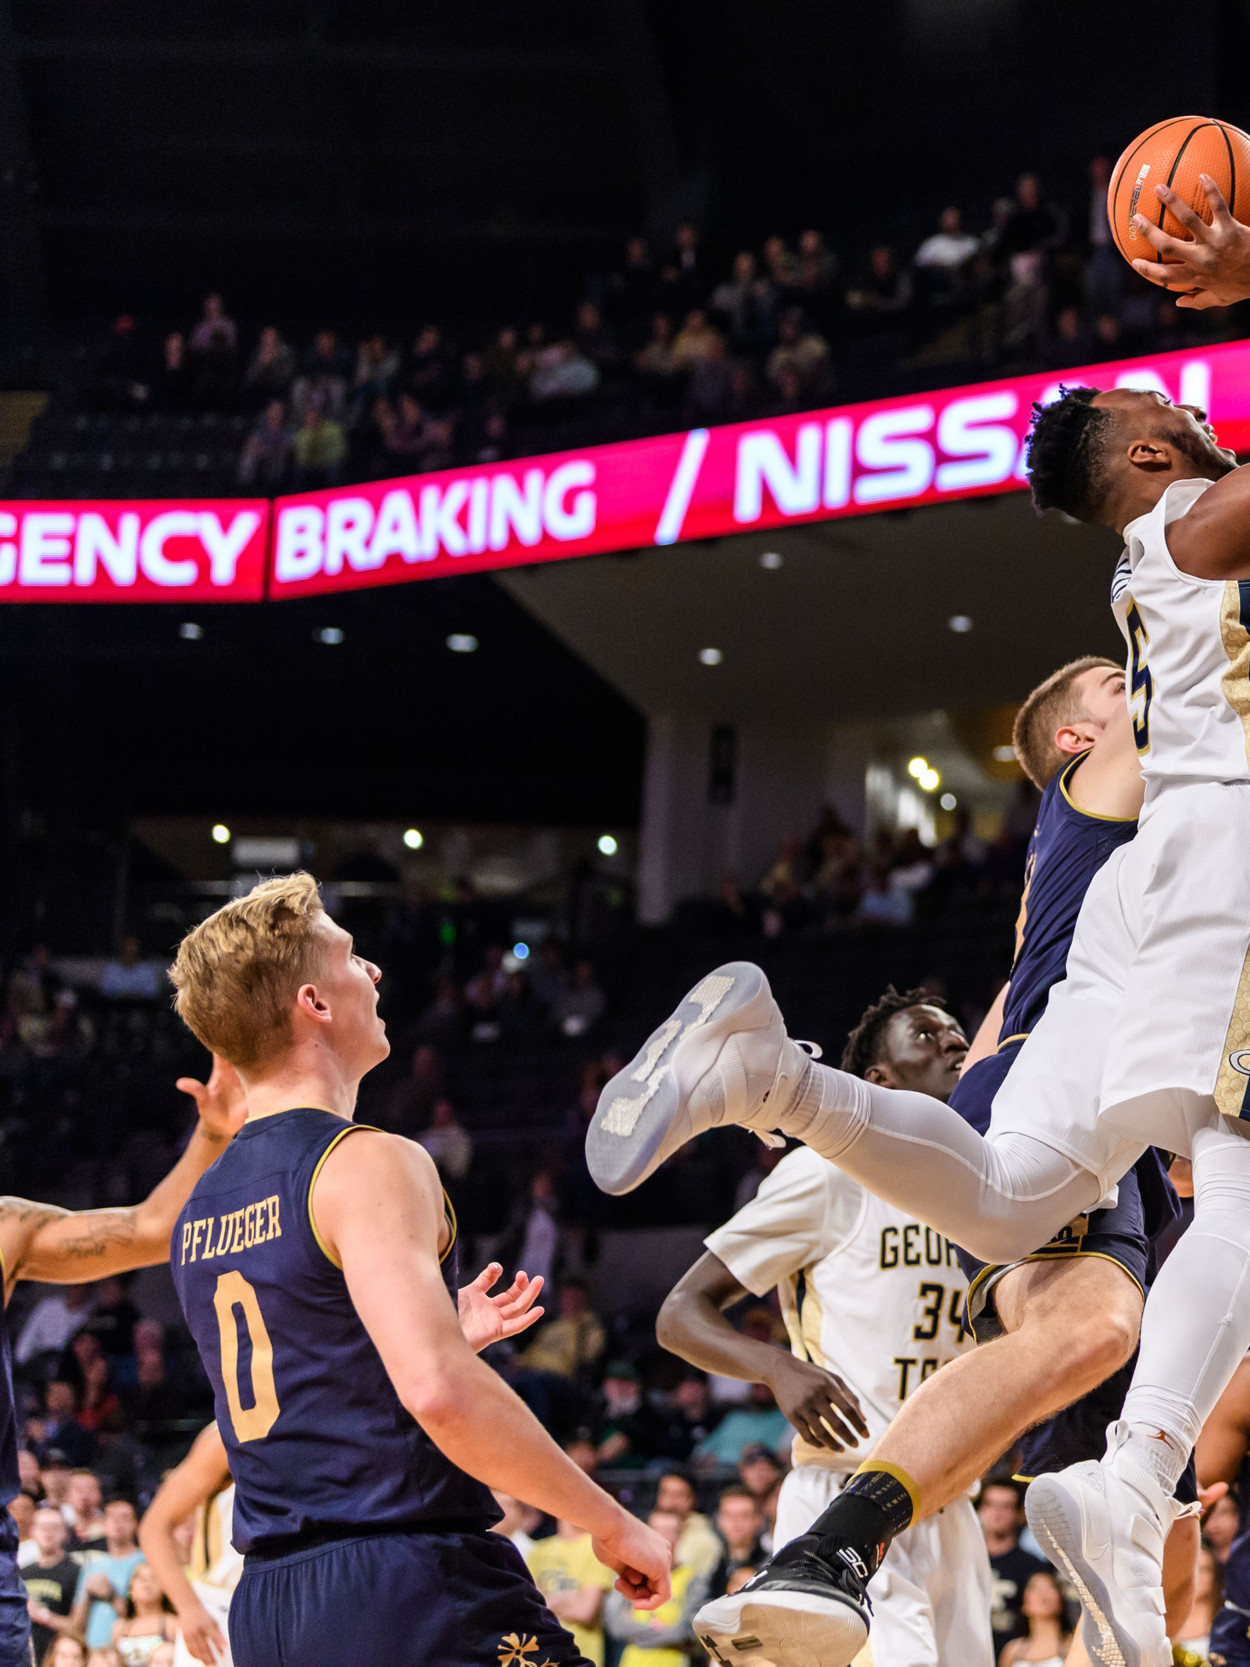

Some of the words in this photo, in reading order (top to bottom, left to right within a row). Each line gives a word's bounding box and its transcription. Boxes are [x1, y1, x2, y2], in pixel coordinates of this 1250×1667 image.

[275, 460, 596, 583] BRAKING
[733, 360, 1211, 522] NISS
[181, 1194, 282, 1266] PFLUEGER
[213, 1269, 281, 1444] 0
[913, 1281, 965, 1344] 34
